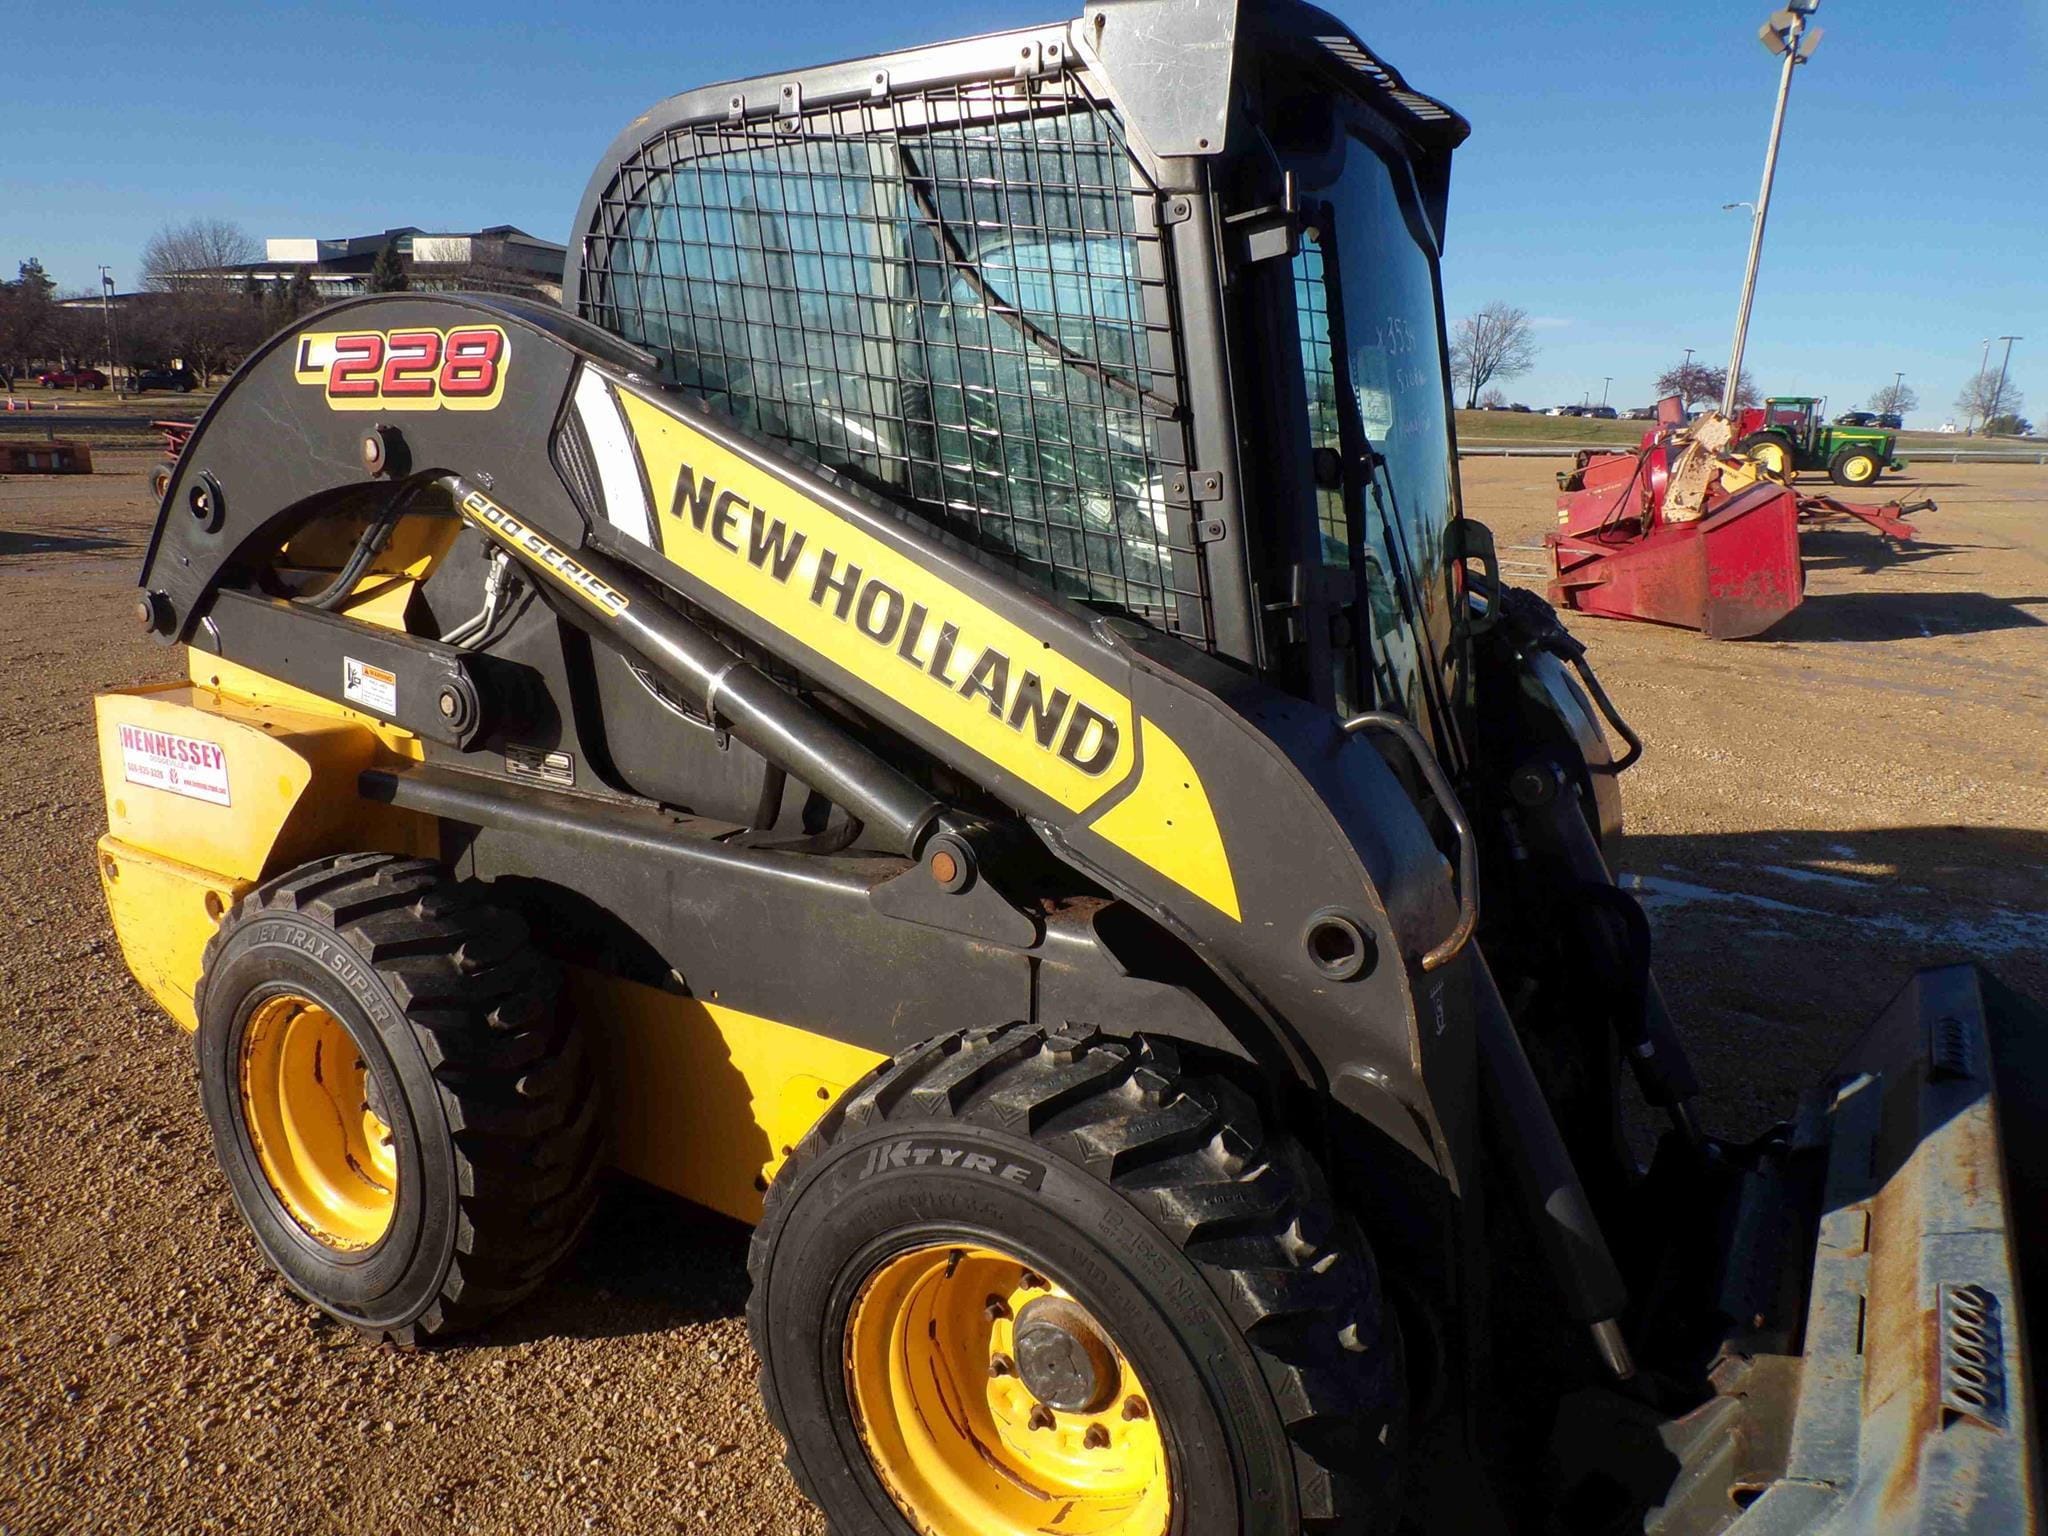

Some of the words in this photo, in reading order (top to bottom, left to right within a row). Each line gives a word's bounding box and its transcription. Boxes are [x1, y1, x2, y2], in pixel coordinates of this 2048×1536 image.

[299, 329, 504, 398] L228
[466, 493, 523, 537] 200
[523, 535, 627, 609] SERIES
[671, 463, 807, 584] NEW
[809, 547, 1121, 778] HOLLAND
[123, 727, 221, 770] HENNESSEY
[283, 926, 330, 960] TRAX
[330, 953, 392, 1023] SUPER
